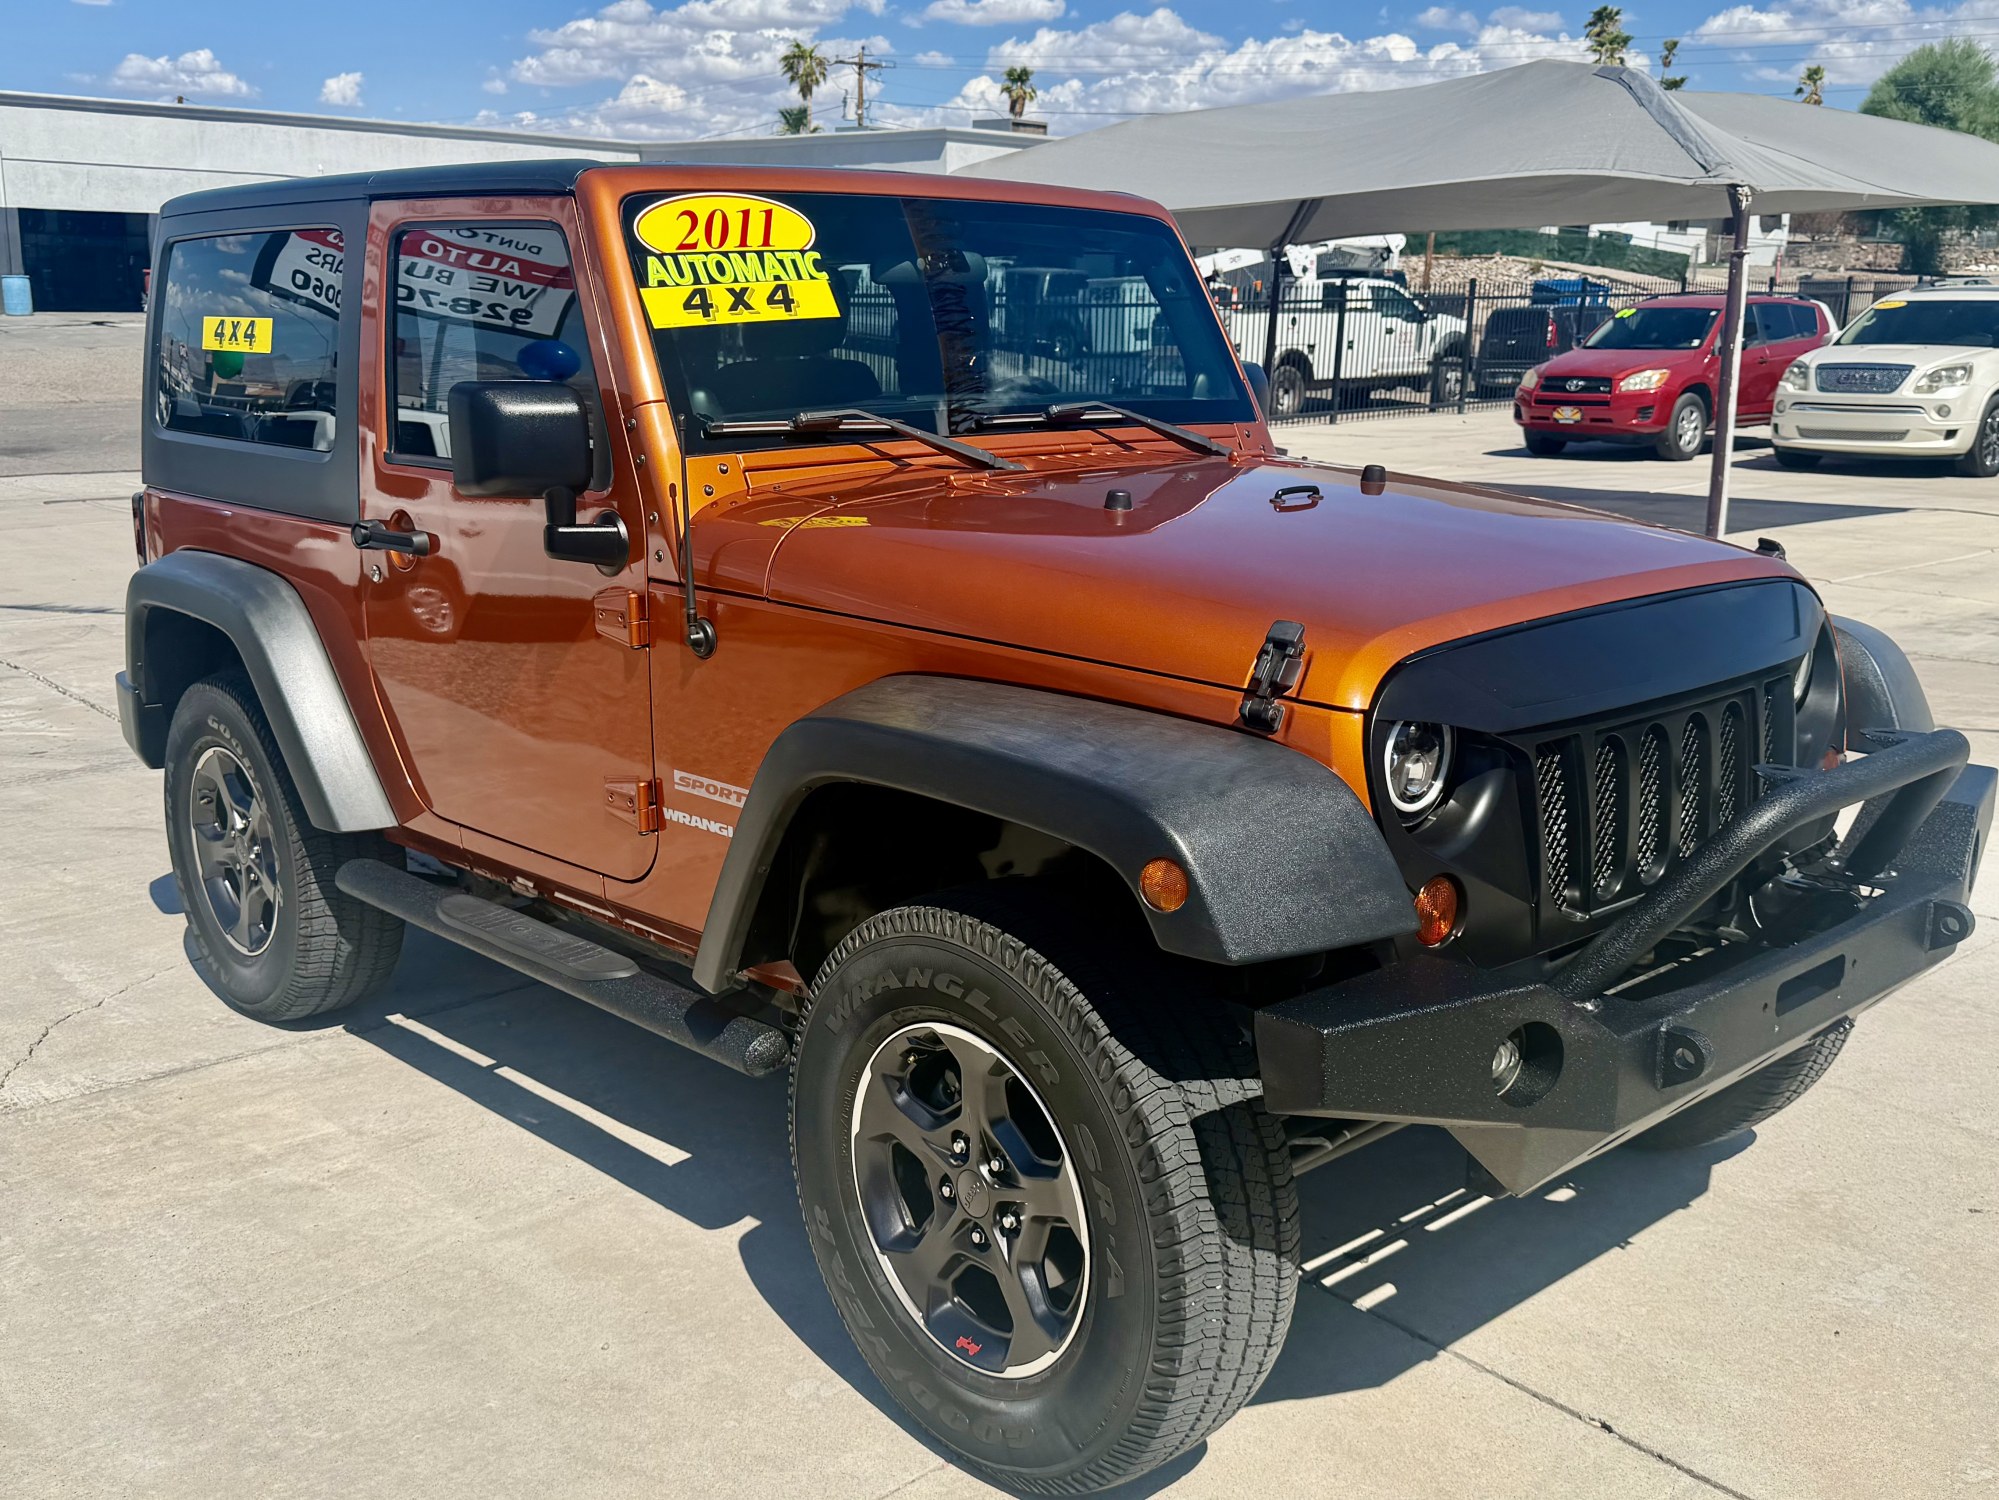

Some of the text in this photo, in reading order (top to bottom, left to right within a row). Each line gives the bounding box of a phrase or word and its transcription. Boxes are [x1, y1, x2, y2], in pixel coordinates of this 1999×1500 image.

[675, 208, 776, 251] 2011
[647, 251, 830, 287] AUTOMATIC
[675, 775, 748, 803] SPORT
[825, 967, 1060, 1085] WRANGLER
